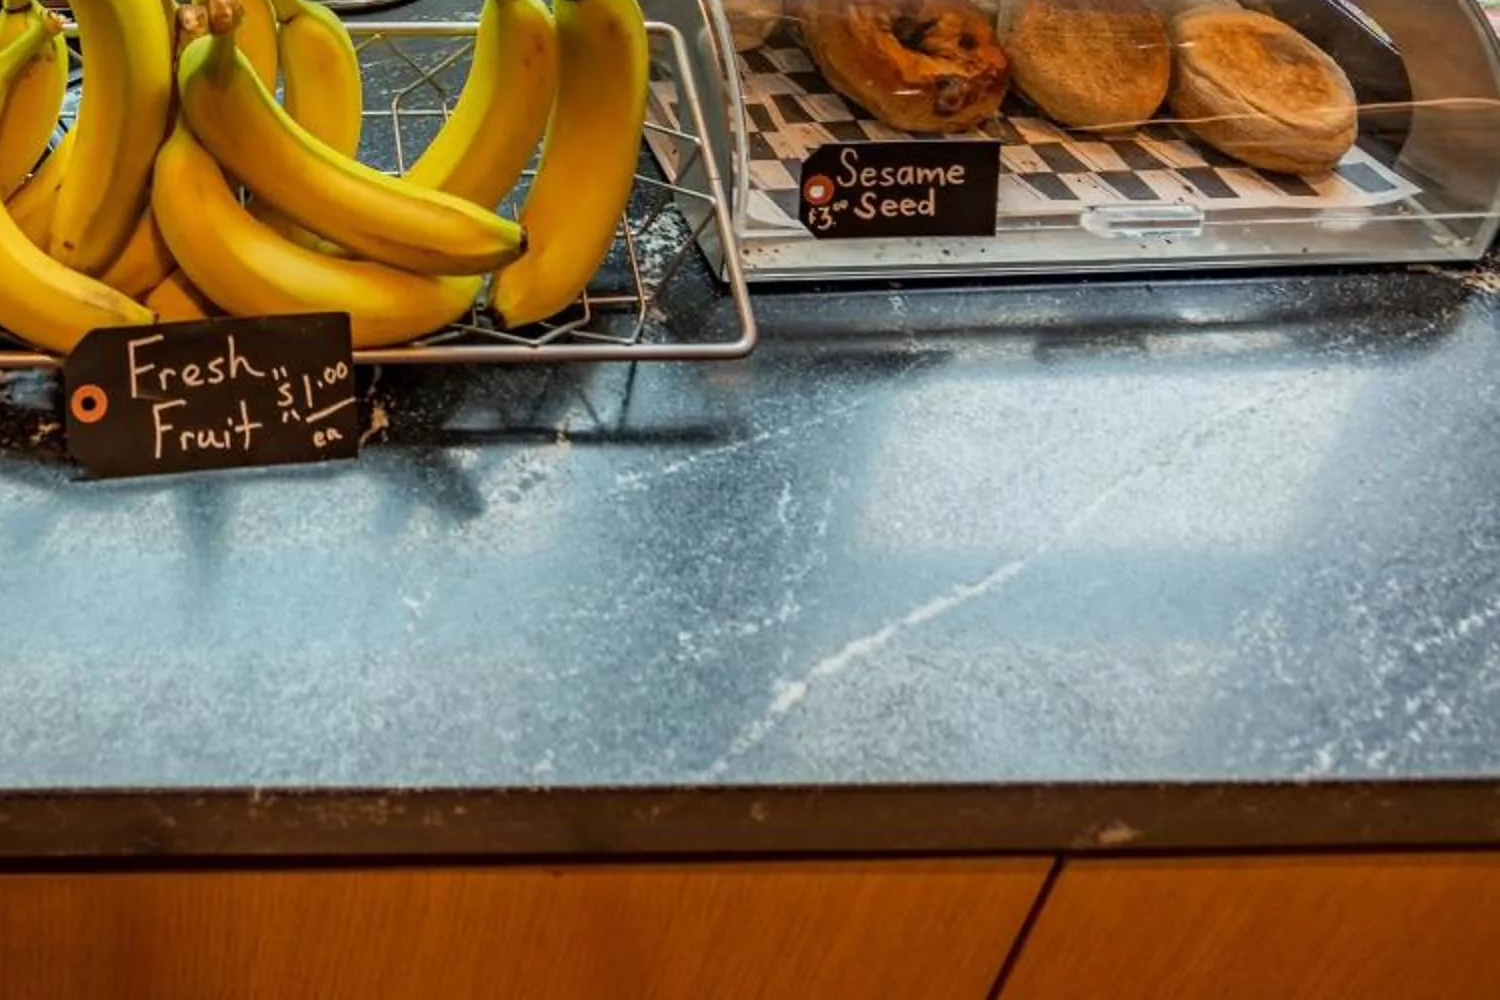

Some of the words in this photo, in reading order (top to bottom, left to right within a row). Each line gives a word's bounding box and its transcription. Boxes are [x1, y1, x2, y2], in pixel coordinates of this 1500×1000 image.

[837, 148, 965, 187] Sesame
[853, 187, 937, 220] Seed
[128, 334, 265, 399] Fresh
[153, 399, 263, 459] Fruit
[312, 427, 345, 448] ea
